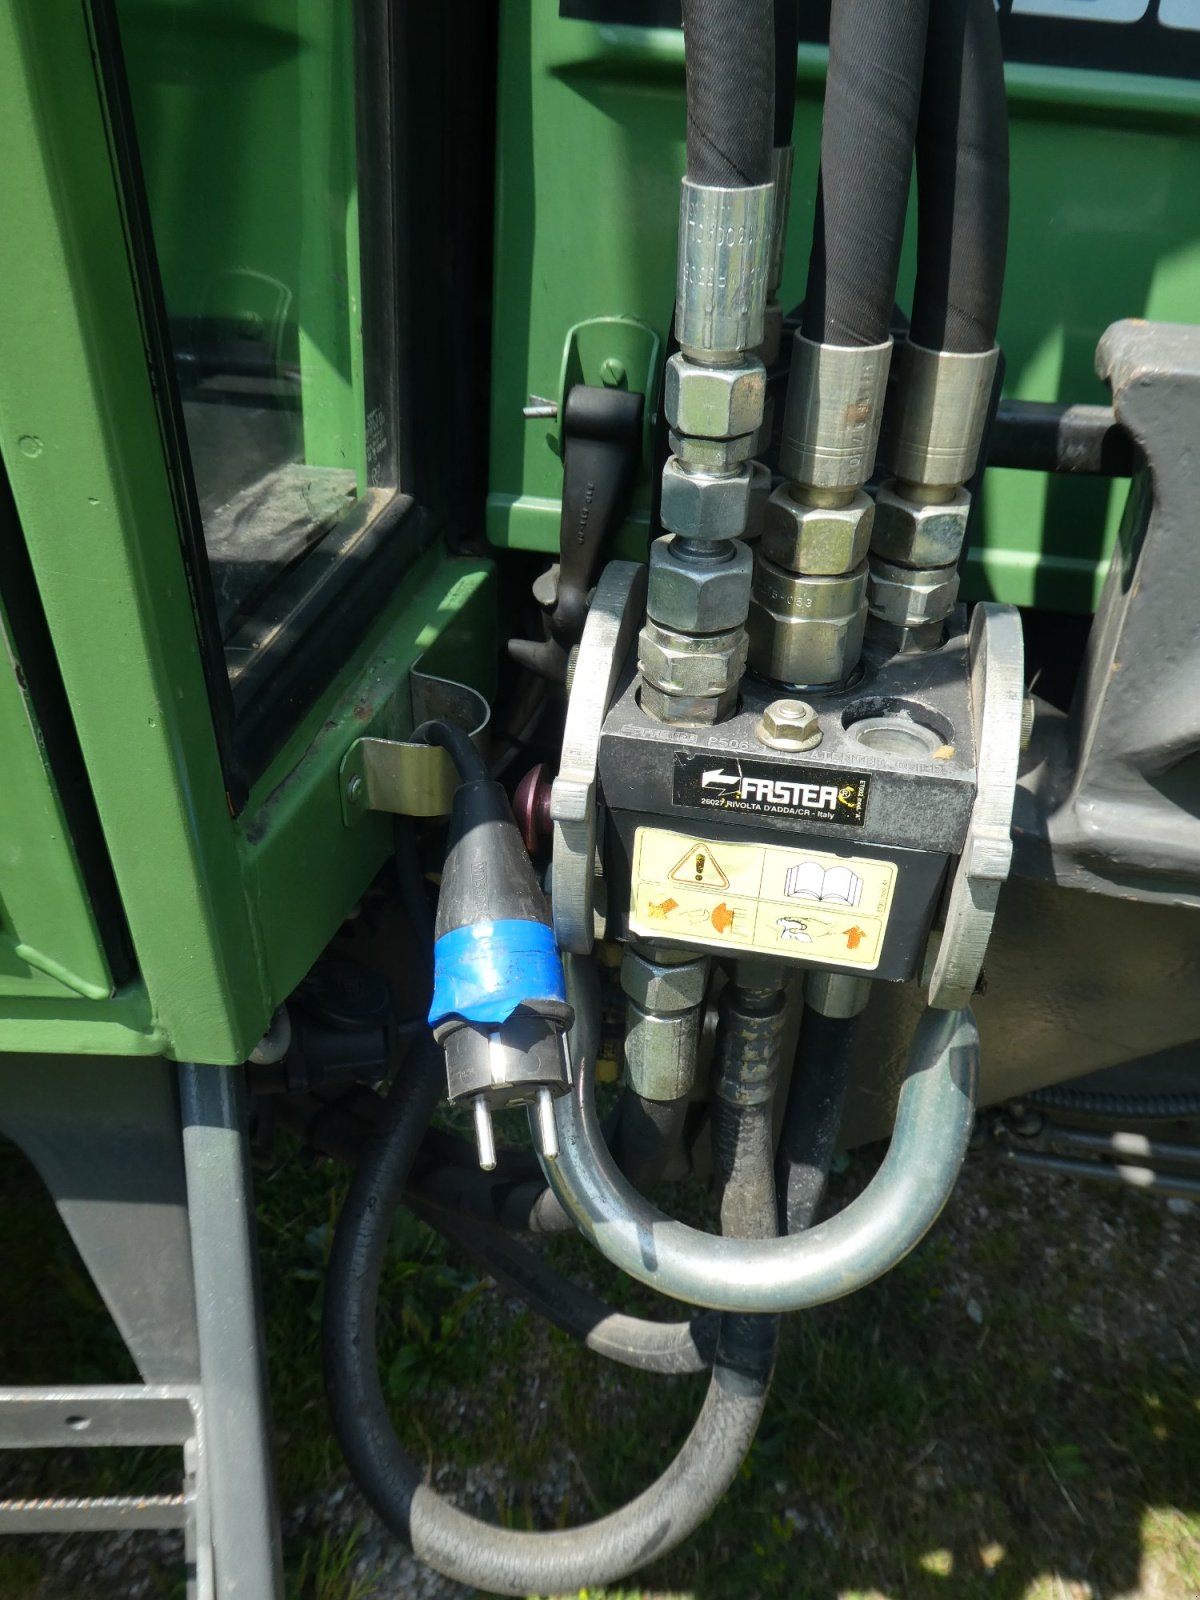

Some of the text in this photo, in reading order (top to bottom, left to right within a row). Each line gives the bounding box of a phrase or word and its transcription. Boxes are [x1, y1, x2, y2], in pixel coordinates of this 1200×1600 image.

[740, 777, 839, 810] FASTER
[701, 798, 725, 808] 26027
[726, 801, 762, 811] RIVOLTA
[763, 804, 810, 817] D'ADDA/CR
[817, 810, 835, 820] Italy
